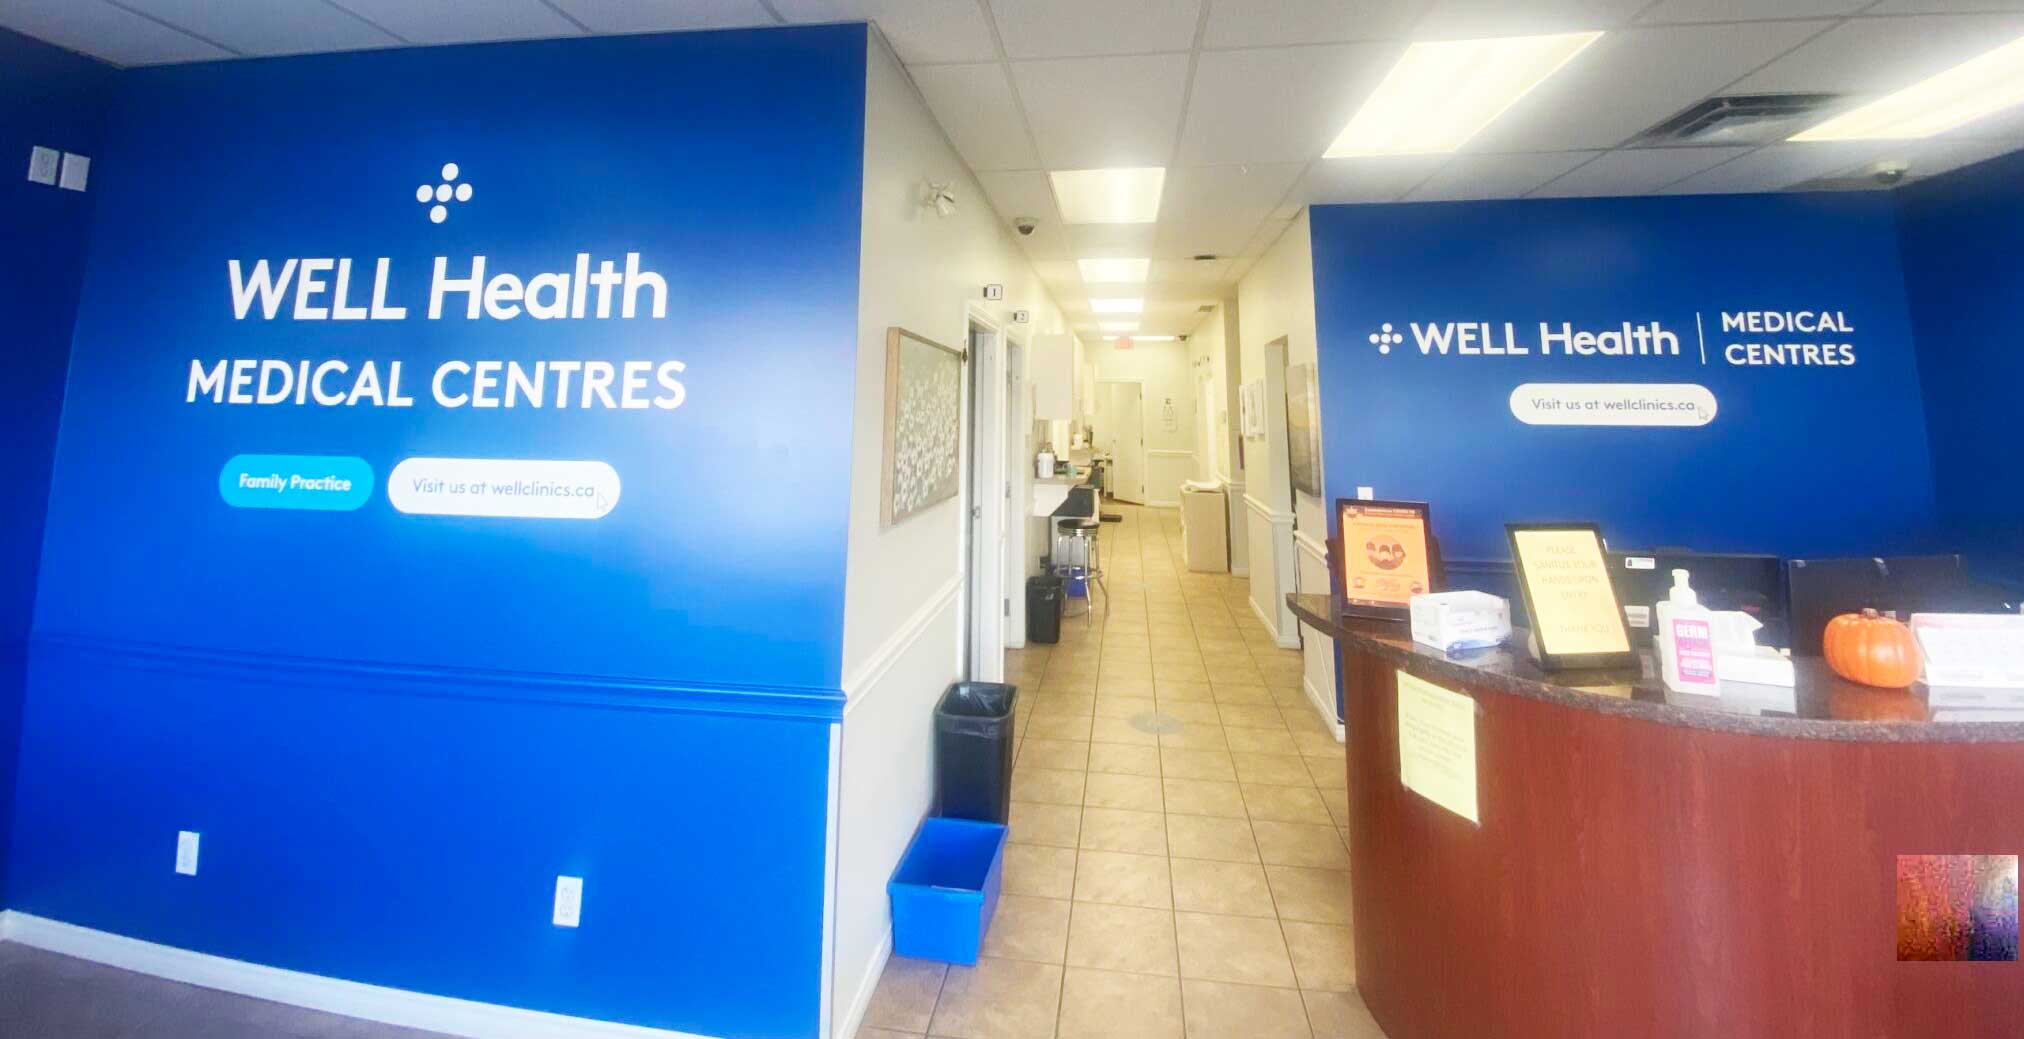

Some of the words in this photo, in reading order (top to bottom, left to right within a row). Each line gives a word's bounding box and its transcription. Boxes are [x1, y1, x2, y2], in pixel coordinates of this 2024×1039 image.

[227, 256, 407, 321] WELL
[427, 252, 669, 320] Health
[1721, 311, 1854, 333] MEDICAL
[1409, 322, 1529, 355] WELL
[1539, 321, 1680, 356] Health
[1724, 343, 1857, 366] CENTRES
[186, 359, 414, 407] MEDICAL
[431, 359, 687, 410] CENTRES
[1531, 398, 1561, 410] Visit
[1566, 402, 1581, 410] us
[1585, 400, 1599, 410] at
[1604, 399, 1696, 411] wellclinics.ca
[239, 472, 287, 494] Family
[290, 474, 352, 493] Practice
[412, 477, 446, 495] Visit
[449, 483, 467, 495] us
[470, 481, 487, 496] at
[491, 480, 596, 499] wellclinics.ca
